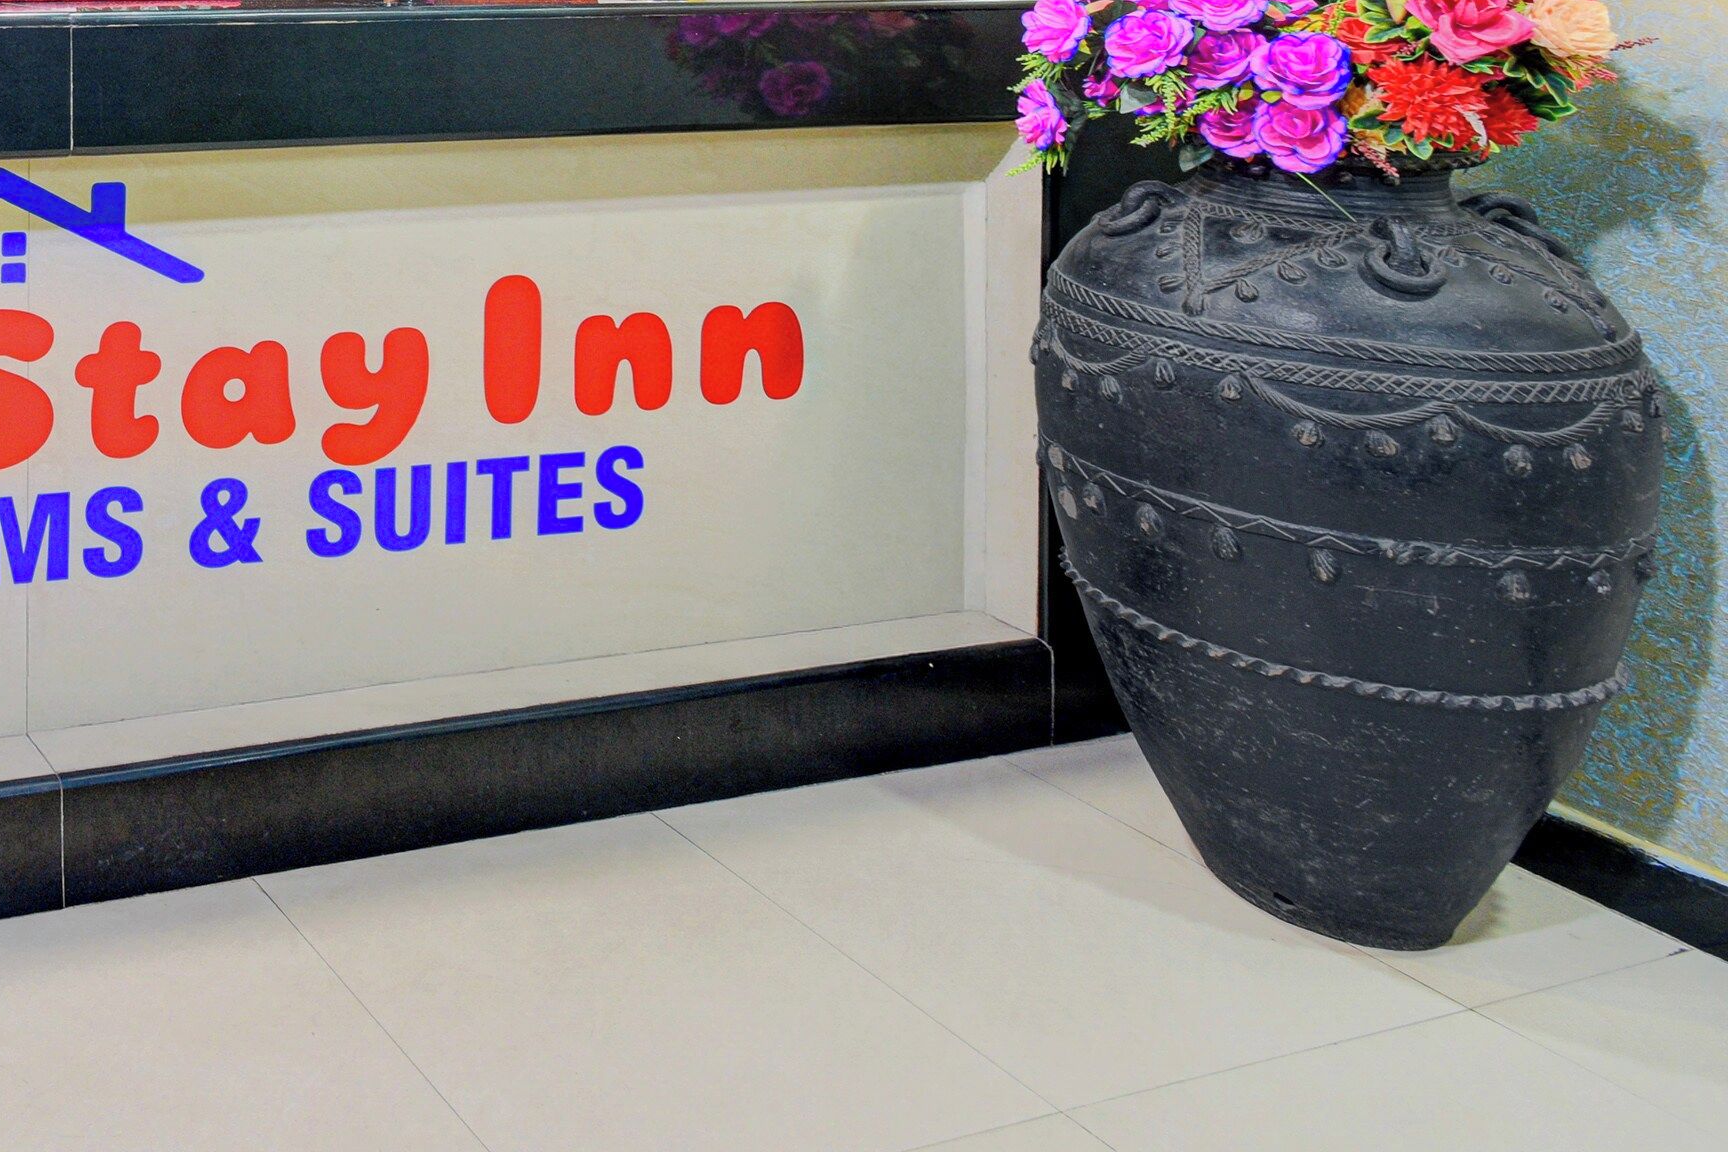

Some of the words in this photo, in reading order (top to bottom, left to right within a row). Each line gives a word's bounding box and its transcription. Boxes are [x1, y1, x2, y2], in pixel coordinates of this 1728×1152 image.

[483, 274, 804, 424] Inn
[189, 477, 262, 569] &
[306, 445, 644, 558] SUITES
